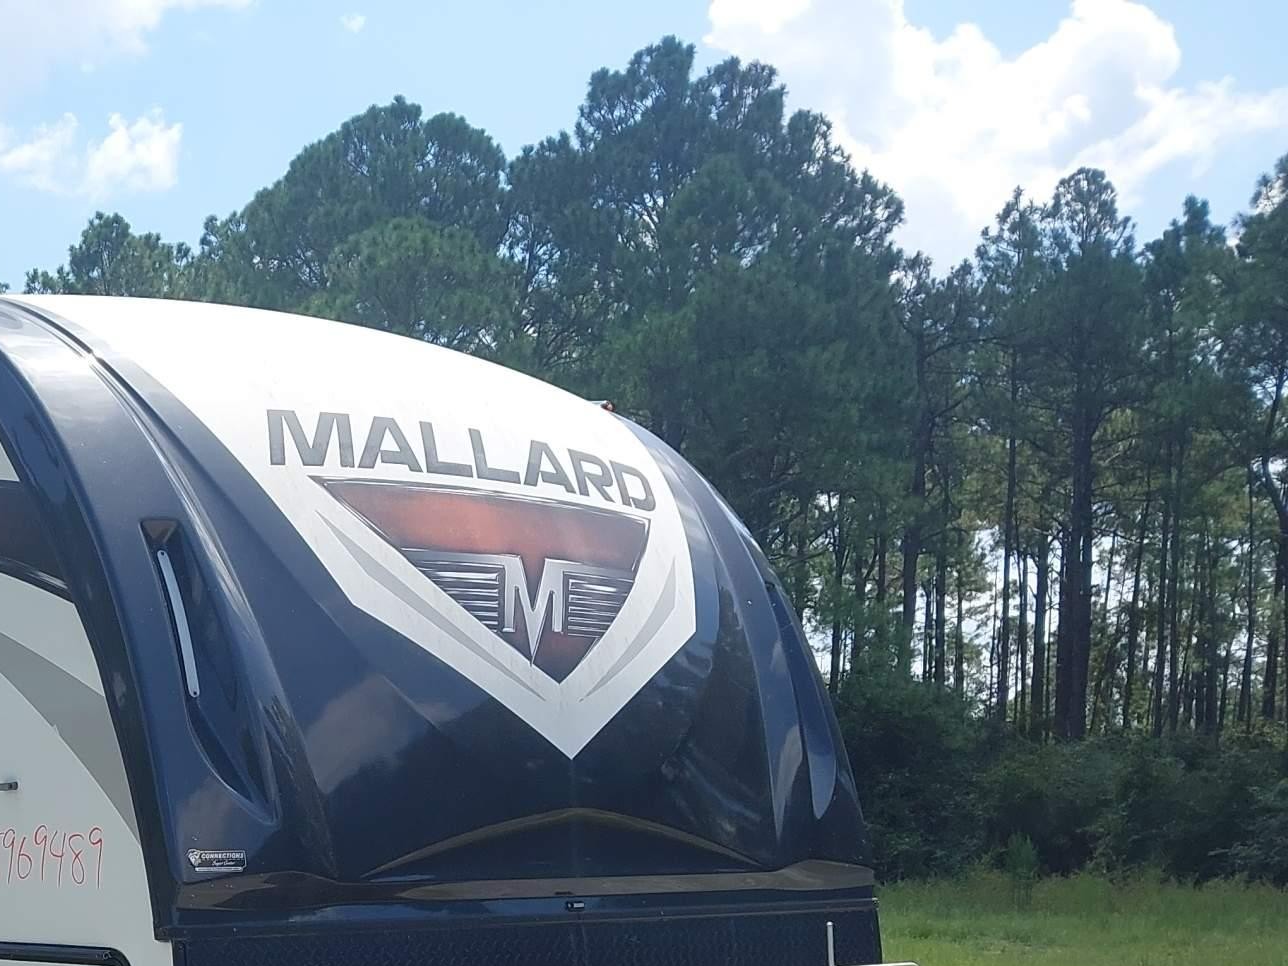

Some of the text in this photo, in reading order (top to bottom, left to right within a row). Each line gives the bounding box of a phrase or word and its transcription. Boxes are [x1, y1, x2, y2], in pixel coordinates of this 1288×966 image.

[266, 408, 656, 512] MALLARD
[501, 554, 565, 667] M
[201, 852, 244, 860] CONNECTIONS
